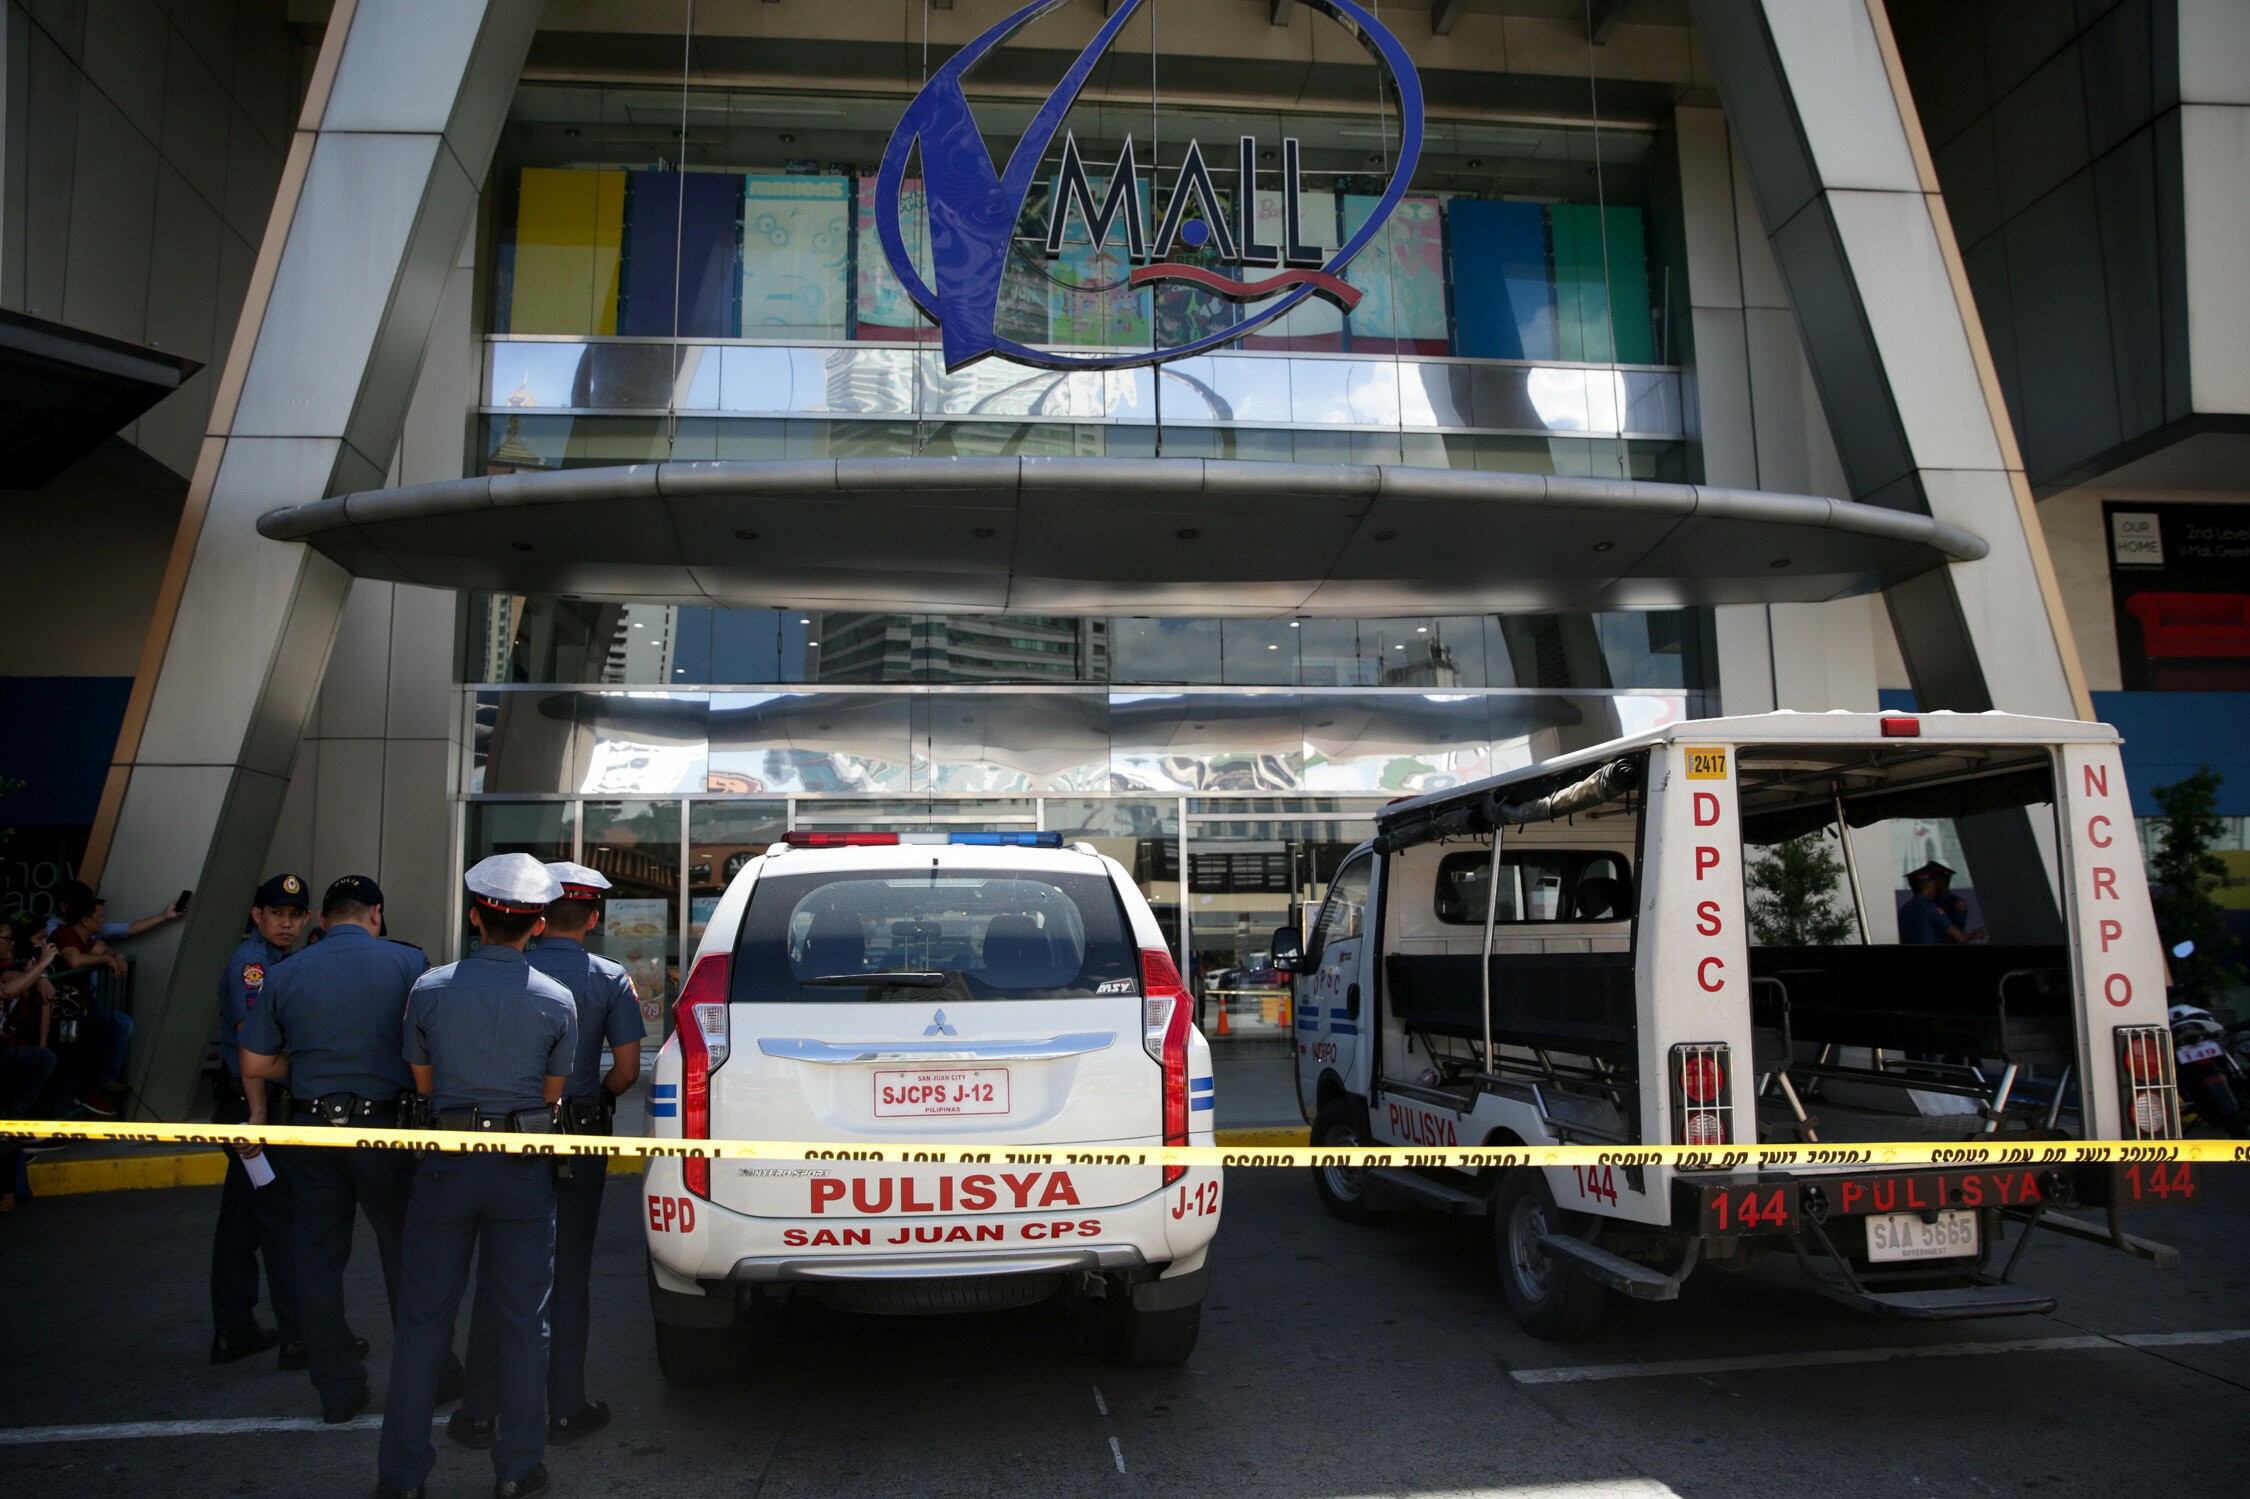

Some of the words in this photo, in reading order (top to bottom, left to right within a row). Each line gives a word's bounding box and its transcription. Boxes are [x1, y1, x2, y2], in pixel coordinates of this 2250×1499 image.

[1046, 129, 1325, 265] MALL
[2122, 521, 2149, 533] OUR
[2118, 541, 2159, 553] HOME
[1695, 755, 1726, 773] 2417
[882, 1085, 947, 1105] SJCPS
[953, 1083, 994, 1103] J-12
[932, 1074, 950, 1082] JUAN
[1389, 1102, 1458, 1147] PULISYA
[809, 1171, 1080, 1214] PULISYA
[1171, 1180, 1219, 1220] J-12
[1573, 1165, 1618, 1206] 144
[1842, 1171, 2043, 1213] PULISYA
[2124, 1162, 2195, 1202] 144
[648, 1195, 696, 1234] EPD
[1711, 1189, 1789, 1231] 144
[783, 1227, 878, 1247] SAN
[888, 1224, 1005, 1244] JUAN
[1021, 1218, 1102, 1240] CPS
[1874, 1222, 1914, 1250] SAA
[1921, 1218, 1972, 1247] 5665
